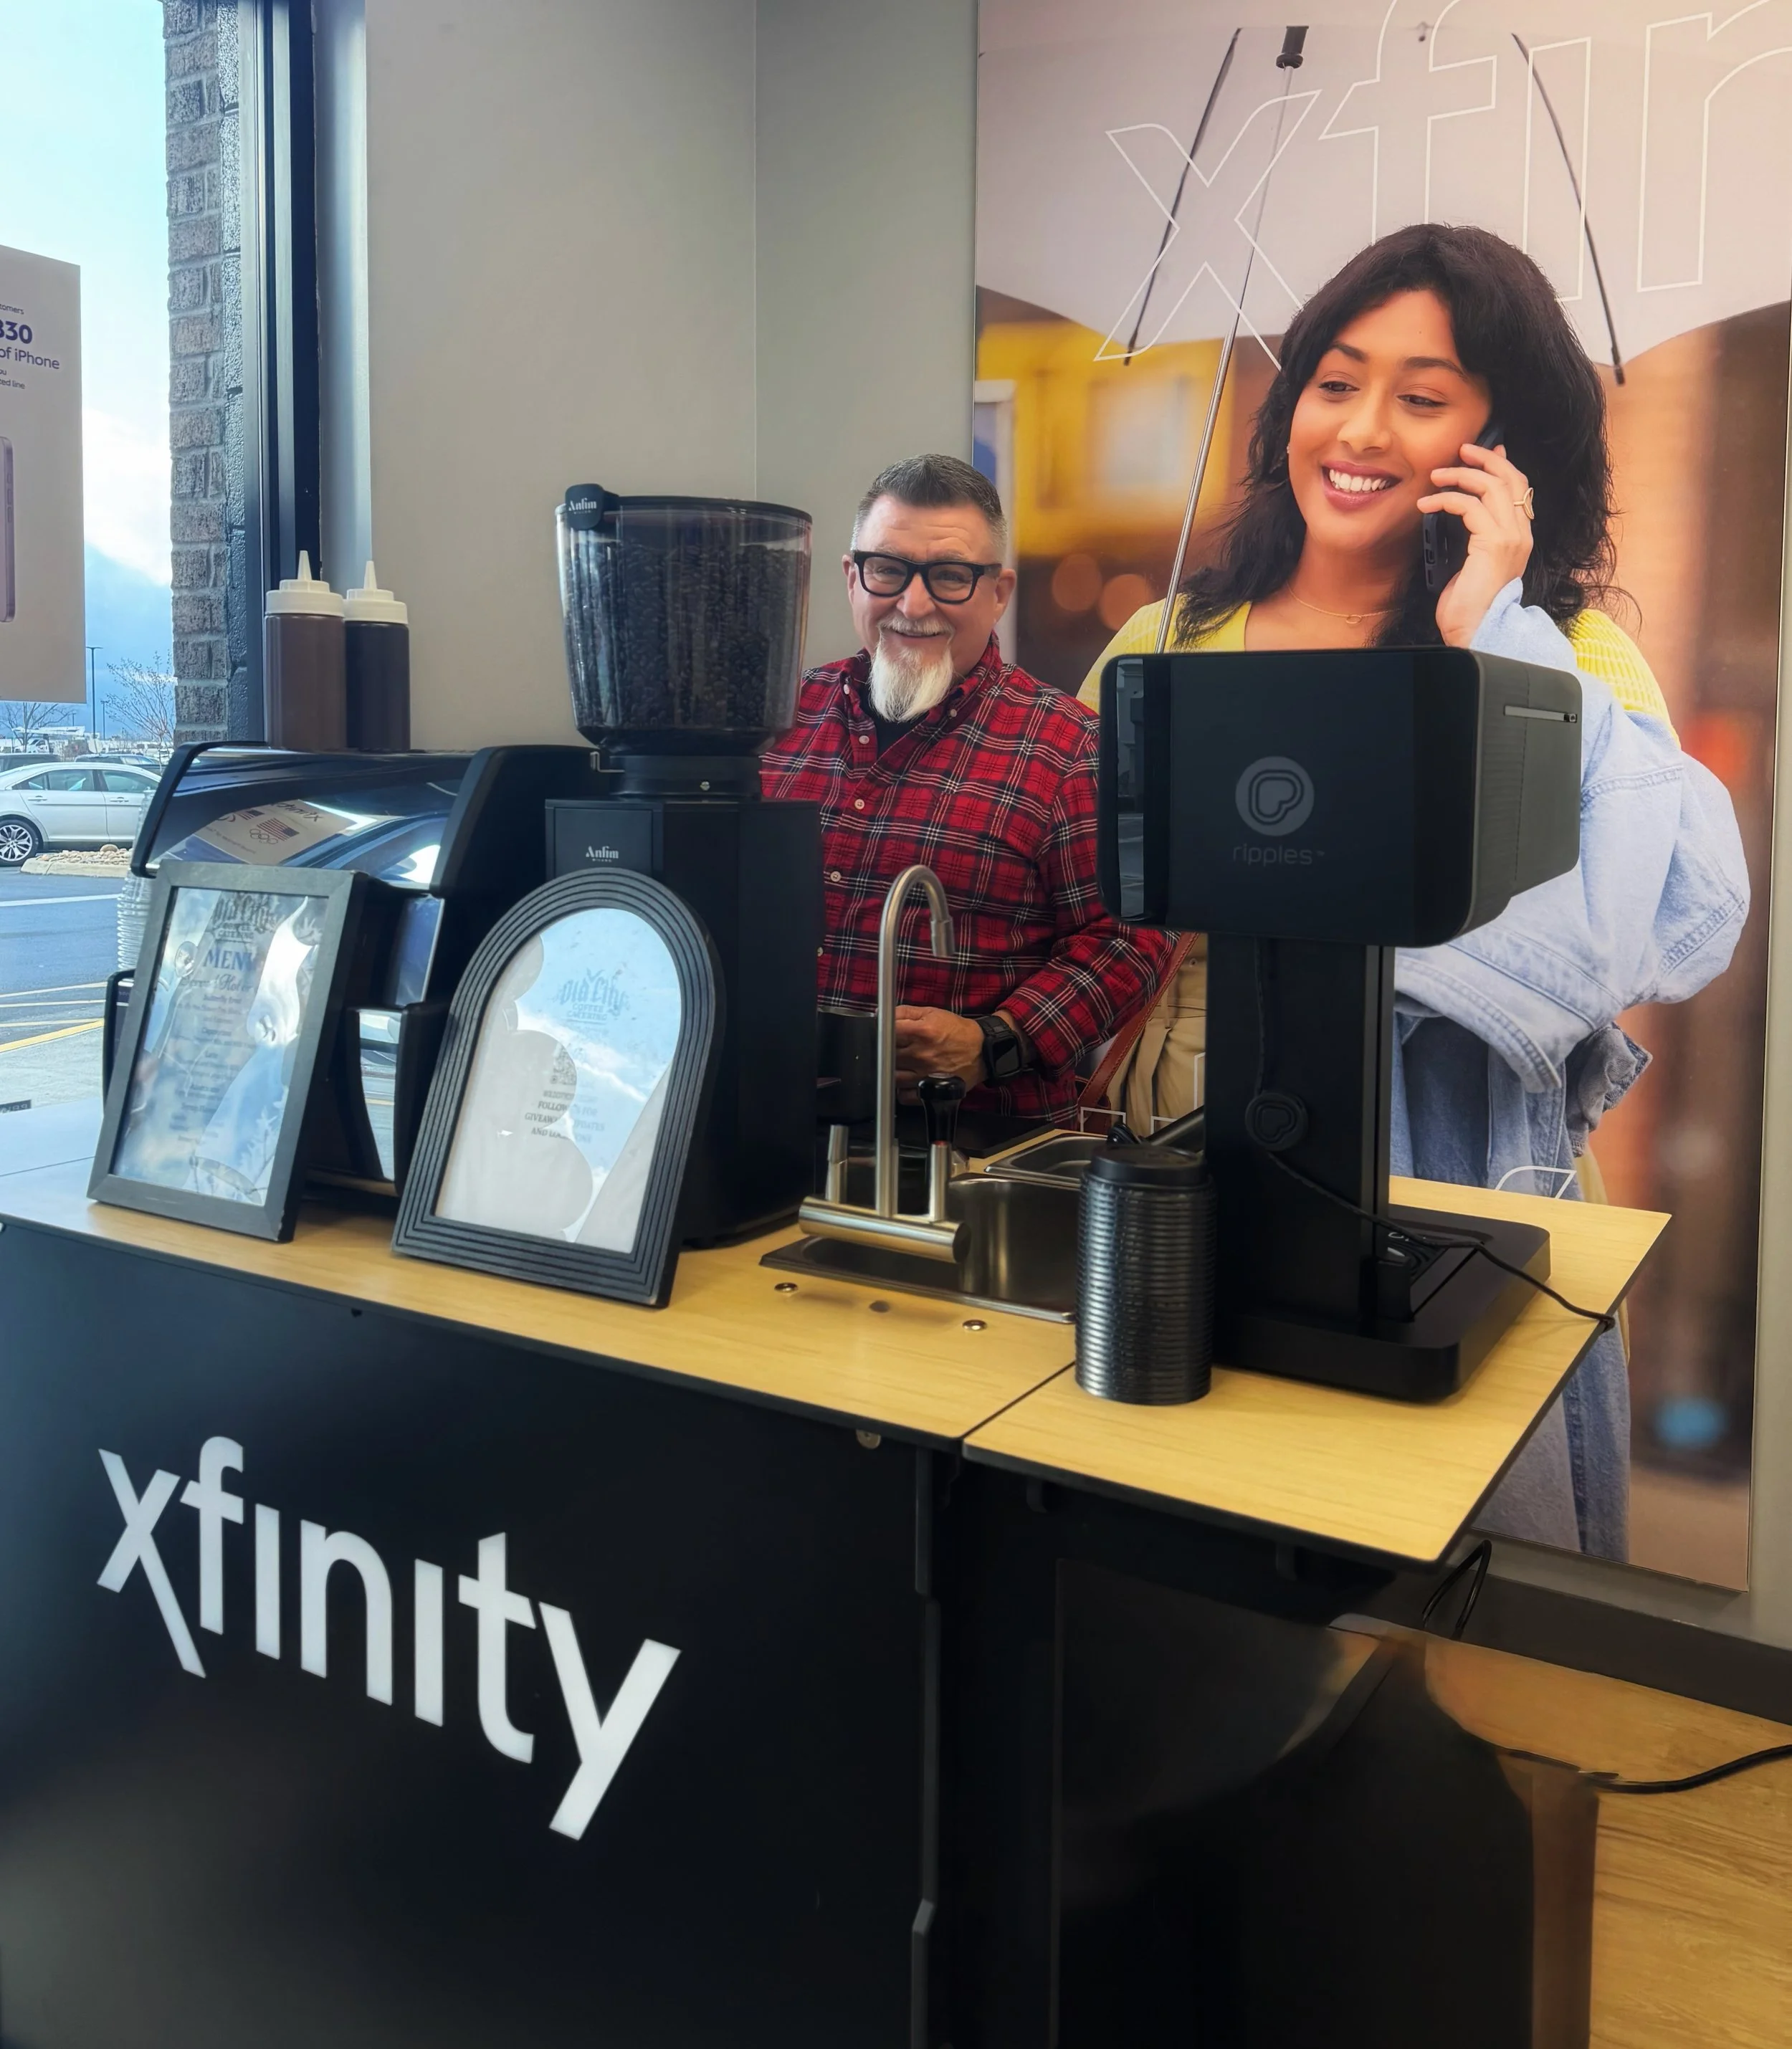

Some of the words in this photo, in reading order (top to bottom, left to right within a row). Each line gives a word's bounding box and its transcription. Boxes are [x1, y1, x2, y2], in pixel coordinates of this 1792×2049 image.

[0, 347, 12, 359] of
[14, 348, 60, 369] iPhone
[12, 380, 25, 389] line
[568, 497, 597, 512] Anfim
[586, 846, 619, 859] Anfim
[1233, 843, 1313, 867] ripples
[531, 1127, 548, 1137] AND
[97, 1436, 682, 1841] xfinity
